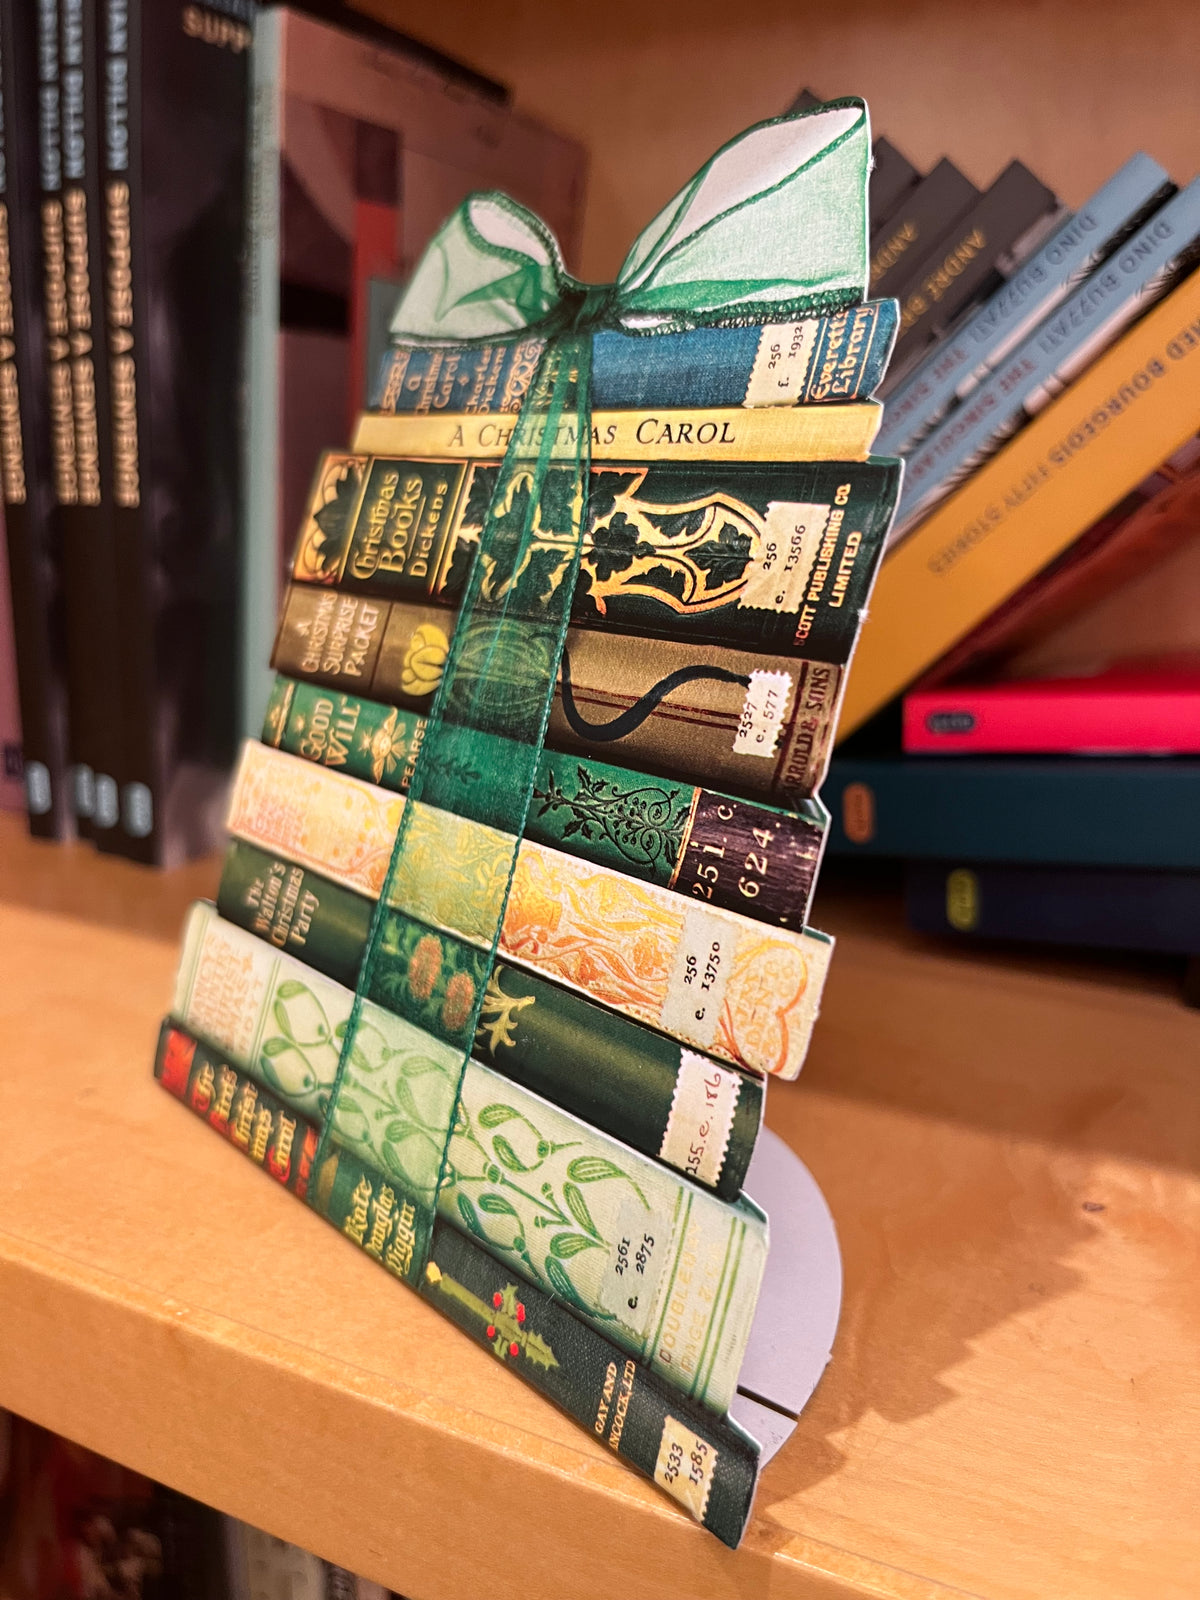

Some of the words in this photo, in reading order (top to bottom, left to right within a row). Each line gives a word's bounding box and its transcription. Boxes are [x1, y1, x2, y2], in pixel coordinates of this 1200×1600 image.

[39, 85, 61, 191] DILLON
[63, 67, 85, 180] DILLON
[106, 55, 128, 171] DILLON
[41, 200, 66, 337] SUPPOSE
[64, 186, 92, 331] SUPPOSE
[107, 179, 134, 328] SUPPOSE
[870, 220, 919, 286] AND
[1045, 213, 1098, 266] DINO
[1118, 218, 1176, 273] DINO
[110, 328, 135, 354] A
[967, 265, 1049, 345] BUZZATI
[1036, 272, 1122, 354] BUZZATI
[48, 337, 70, 361] A
[68, 331, 93, 357] A
[767, 343, 782, 370] 256
[787, 325, 804, 359] 1932
[831, 307, 875, 394] Library
[999, 356, 1038, 396] THE
[432, 355, 462, 409] Carol
[1049, 355, 1167, 466] BOURGEOIS
[50, 361, 79, 507] SENTENCE
[71, 356, 101, 508] SENTENCE
[110, 354, 140, 509] SENTENCE
[448, 425, 464, 447] A
[478, 423, 617, 448] CHRISTMAS
[636, 417, 736, 445] CAROL
[351, 470, 399, 579] Christmas
[378, 476, 424, 573] Books
[410, 480, 449, 577] Dickens
[762, 542, 777, 571] 256
[775, 589, 786, 605] e.
[784, 524, 806, 572] 13566
[793, 604, 817, 647] SCOTT
[807, 508, 845, 601] PUBLISHING
[828, 531, 863, 608] LIMITED
[296, 620, 313, 638] A
[301, 592, 338, 673] CHRISTMAS
[322, 596, 359, 675] SURPRISE
[343, 603, 380, 677] PACKET
[738, 702, 757, 738] 2527
[763, 689, 778, 720] 577
[806, 667, 831, 712] SONS
[300, 698, 334, 762] GOOD
[324, 695, 361, 766] WILL
[401, 718, 428, 788] PEARSE
[253, 861, 286, 932] Walton's
[271, 866, 305, 948] Christmas
[289, 889, 320, 946] Party
[684, 954, 698, 985] 256
[694, 1007, 706, 1021] e.
[700, 941, 721, 991] 13750
[267, 1110, 297, 1185] Carol
[344, 1173, 373, 1246] Kate
[615, 1236, 631, 1277] 2561
[627, 1295, 639, 1310] e.
[635, 1233, 655, 1275] 2875
[594, 1398, 610, 1435] GAY
[603, 1362, 618, 1402] AND
[664, 1442, 684, 1484] 2533
[689, 1438, 708, 1486] 1585
